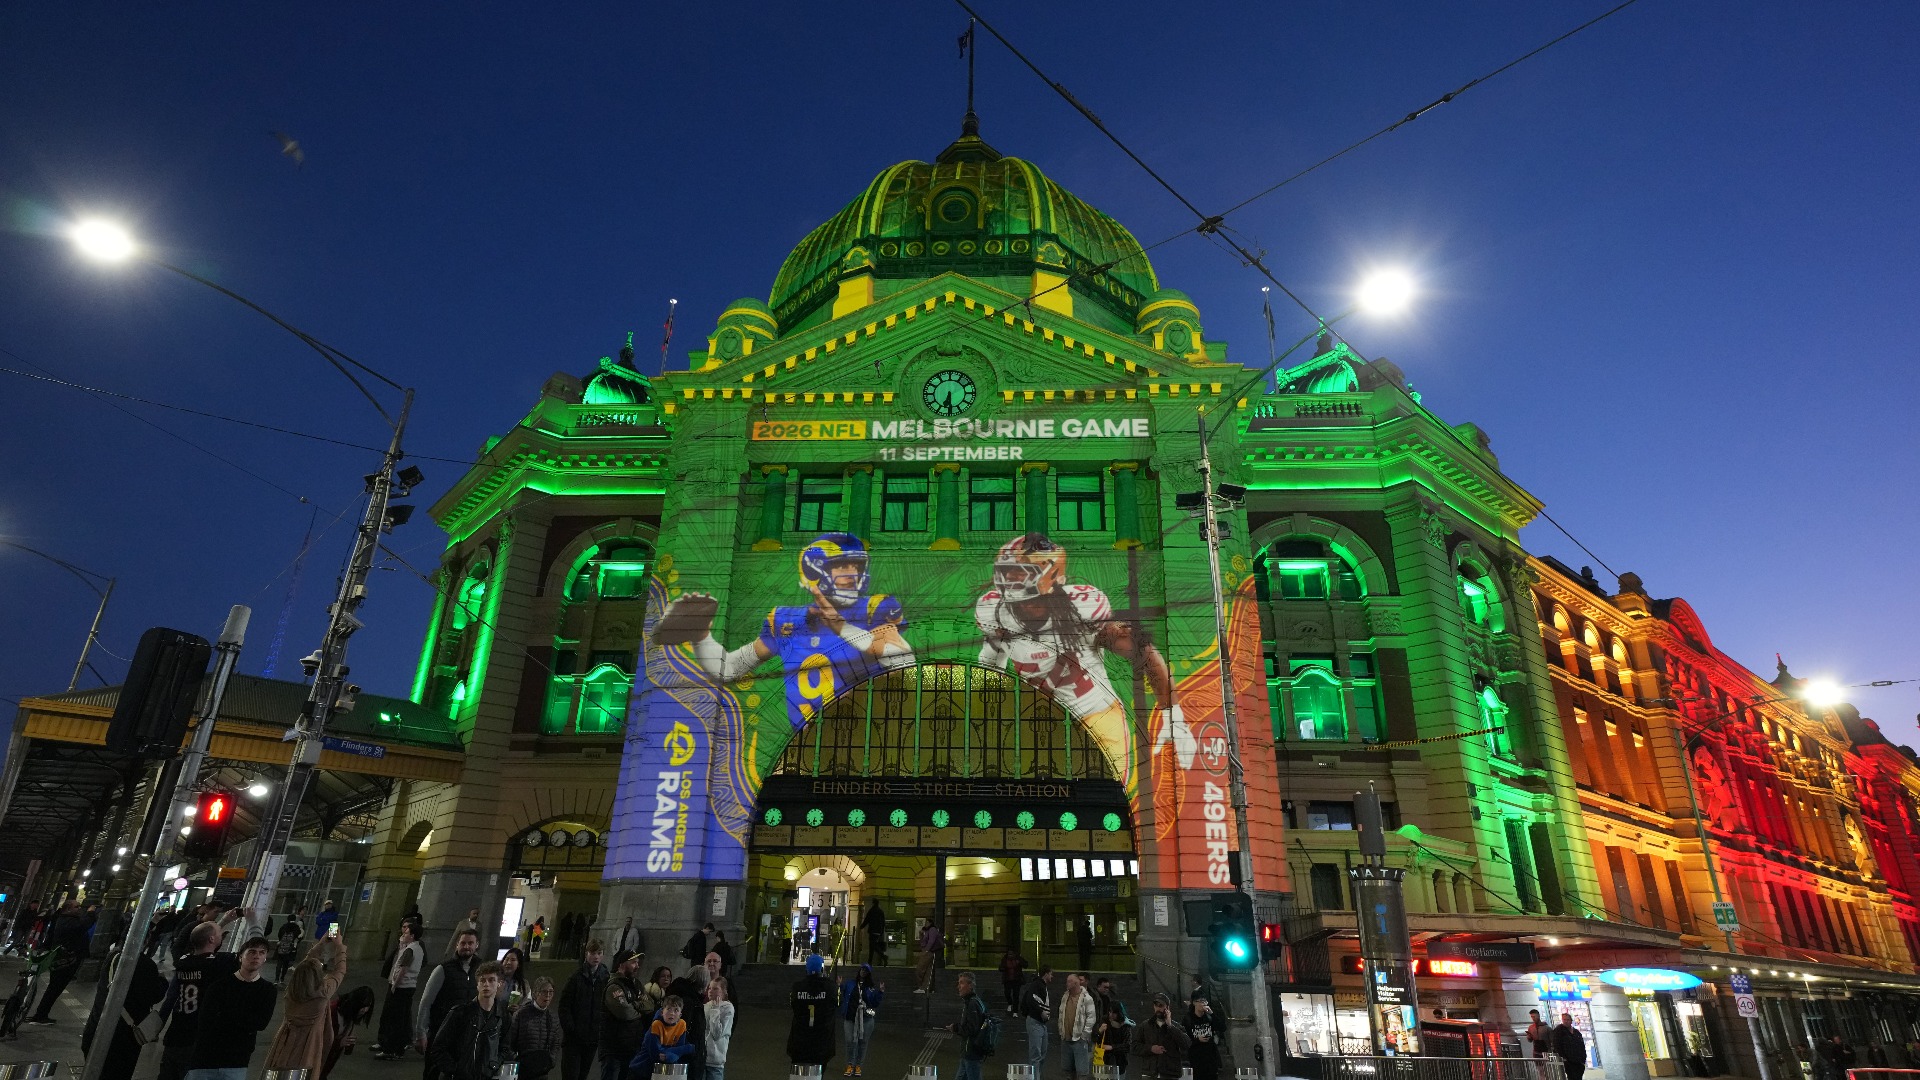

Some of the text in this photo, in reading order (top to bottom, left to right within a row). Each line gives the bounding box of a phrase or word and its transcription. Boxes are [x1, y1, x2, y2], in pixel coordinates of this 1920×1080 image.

[758, 423, 861, 439] 2026 NFL
[872, 417, 1149, 440] MELBOURNE GAME
[880, 446, 1023, 461] 11 SEPTEMBER
[798, 653, 835, 721] 9
[341, 740, 384, 755] Flinders St
[812, 781, 1070, 798] FLINDERS STREET STATION
[647, 771, 681, 873] RAMS
[671, 771, 693, 872] LOS ANGELES
[1203, 781, 1231, 885] 49ERS
[1073, 885, 1096, 893] Customer
[1465, 947, 1507, 957] CityHatters
[177, 970, 202, 980] WILLIAMS
[1549, 977, 1580, 994] EzyMart
[178, 983, 199, 1014] 18
[1740, 1000, 1754, 1010] 40
[807, 1004, 815, 1027] 1
